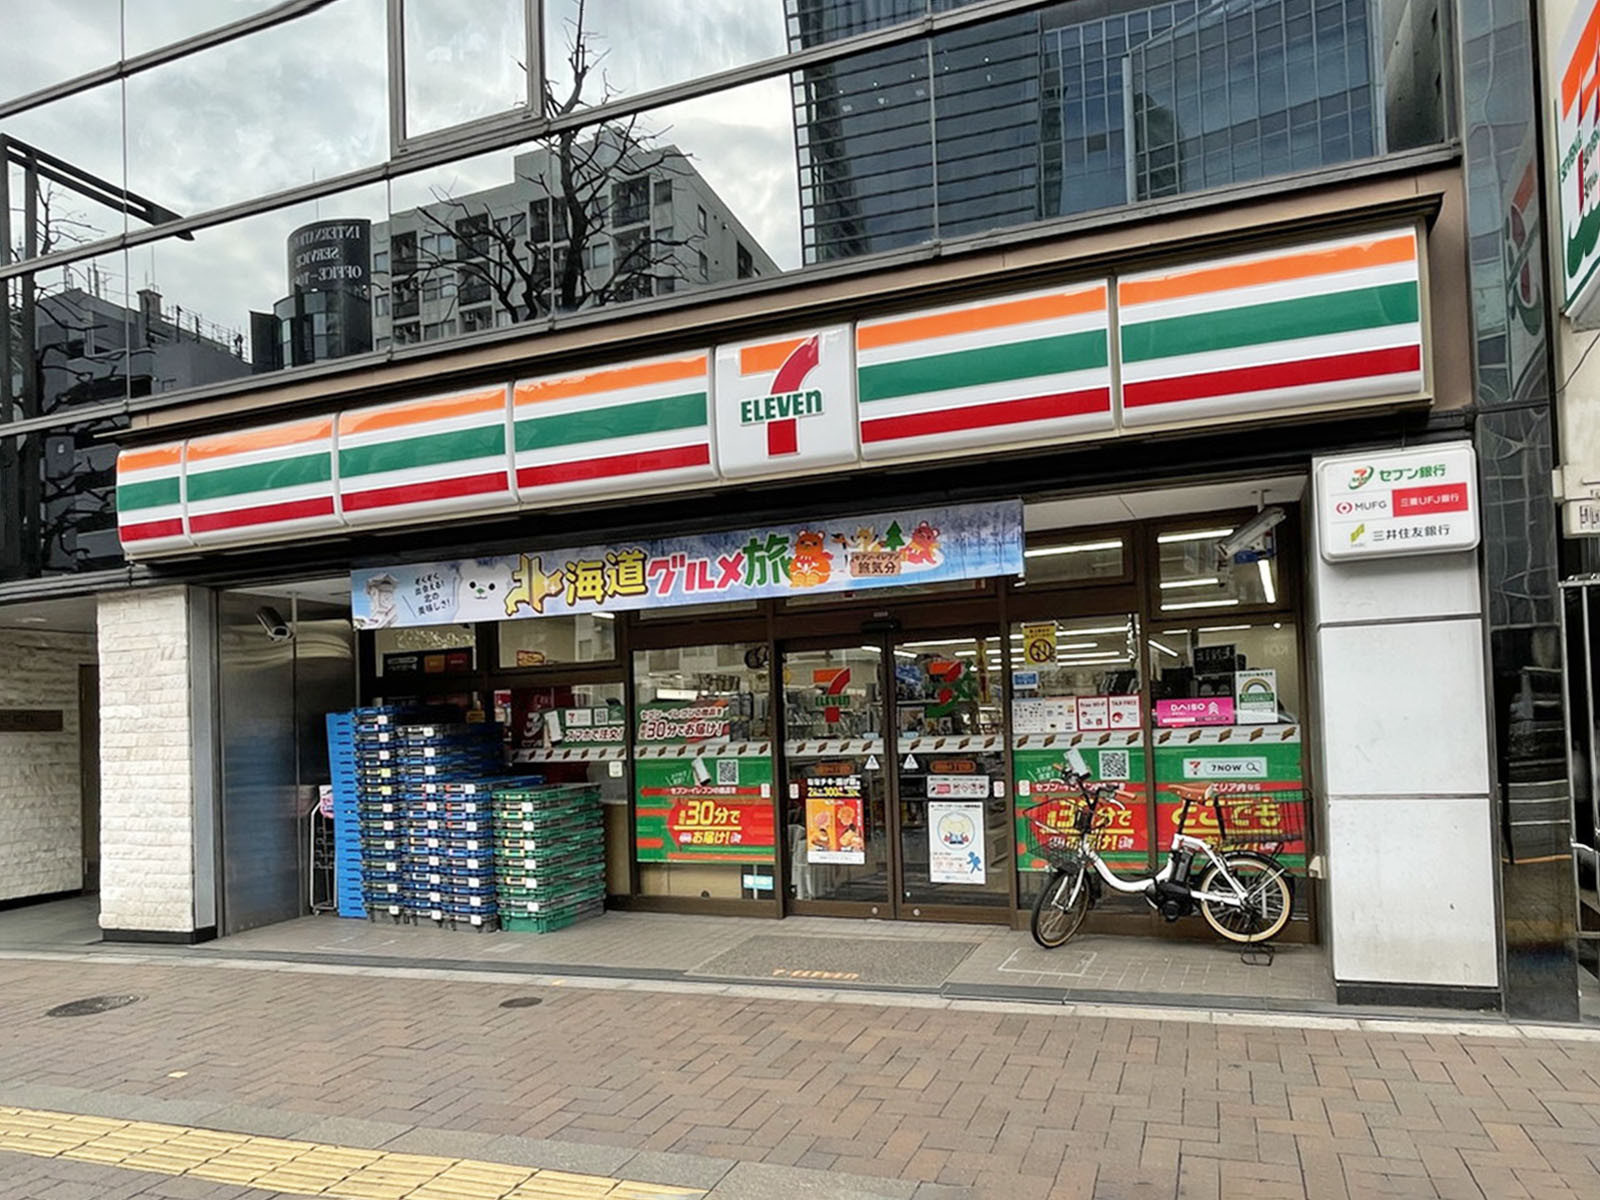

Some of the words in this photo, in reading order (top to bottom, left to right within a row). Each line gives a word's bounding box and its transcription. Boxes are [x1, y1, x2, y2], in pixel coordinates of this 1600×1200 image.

[1379, 464, 1446, 483] セブン銀行
[1355, 501, 1387, 511] MUFG
[1373, 524, 1451, 542] 三井住友銀行
[1170, 703, 1206, 712] DAISO
